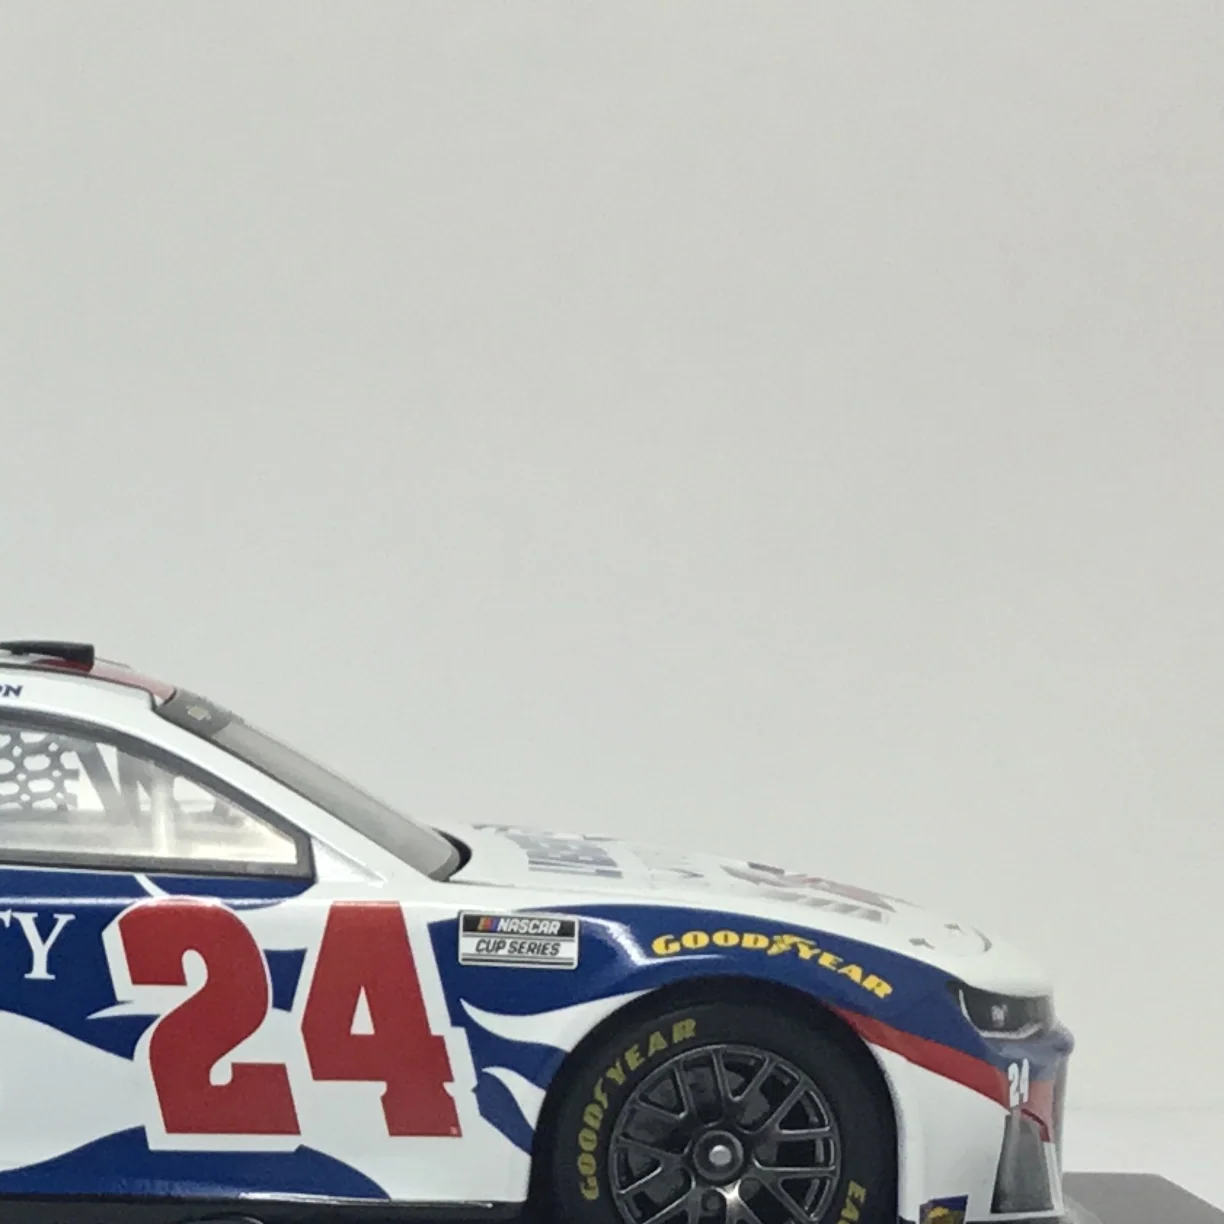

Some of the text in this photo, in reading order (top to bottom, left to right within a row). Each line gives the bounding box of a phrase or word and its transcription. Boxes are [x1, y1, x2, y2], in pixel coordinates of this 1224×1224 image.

[475, 939, 561, 956] CUP SERIES
[496, 918, 561, 935] NASCAR
[651, 929, 894, 999] GOODYEAR
[117, 896, 464, 1139] 24
[576, 1017, 697, 1201] GOODYEAR
[1007, 1057, 1031, 1108] 24
